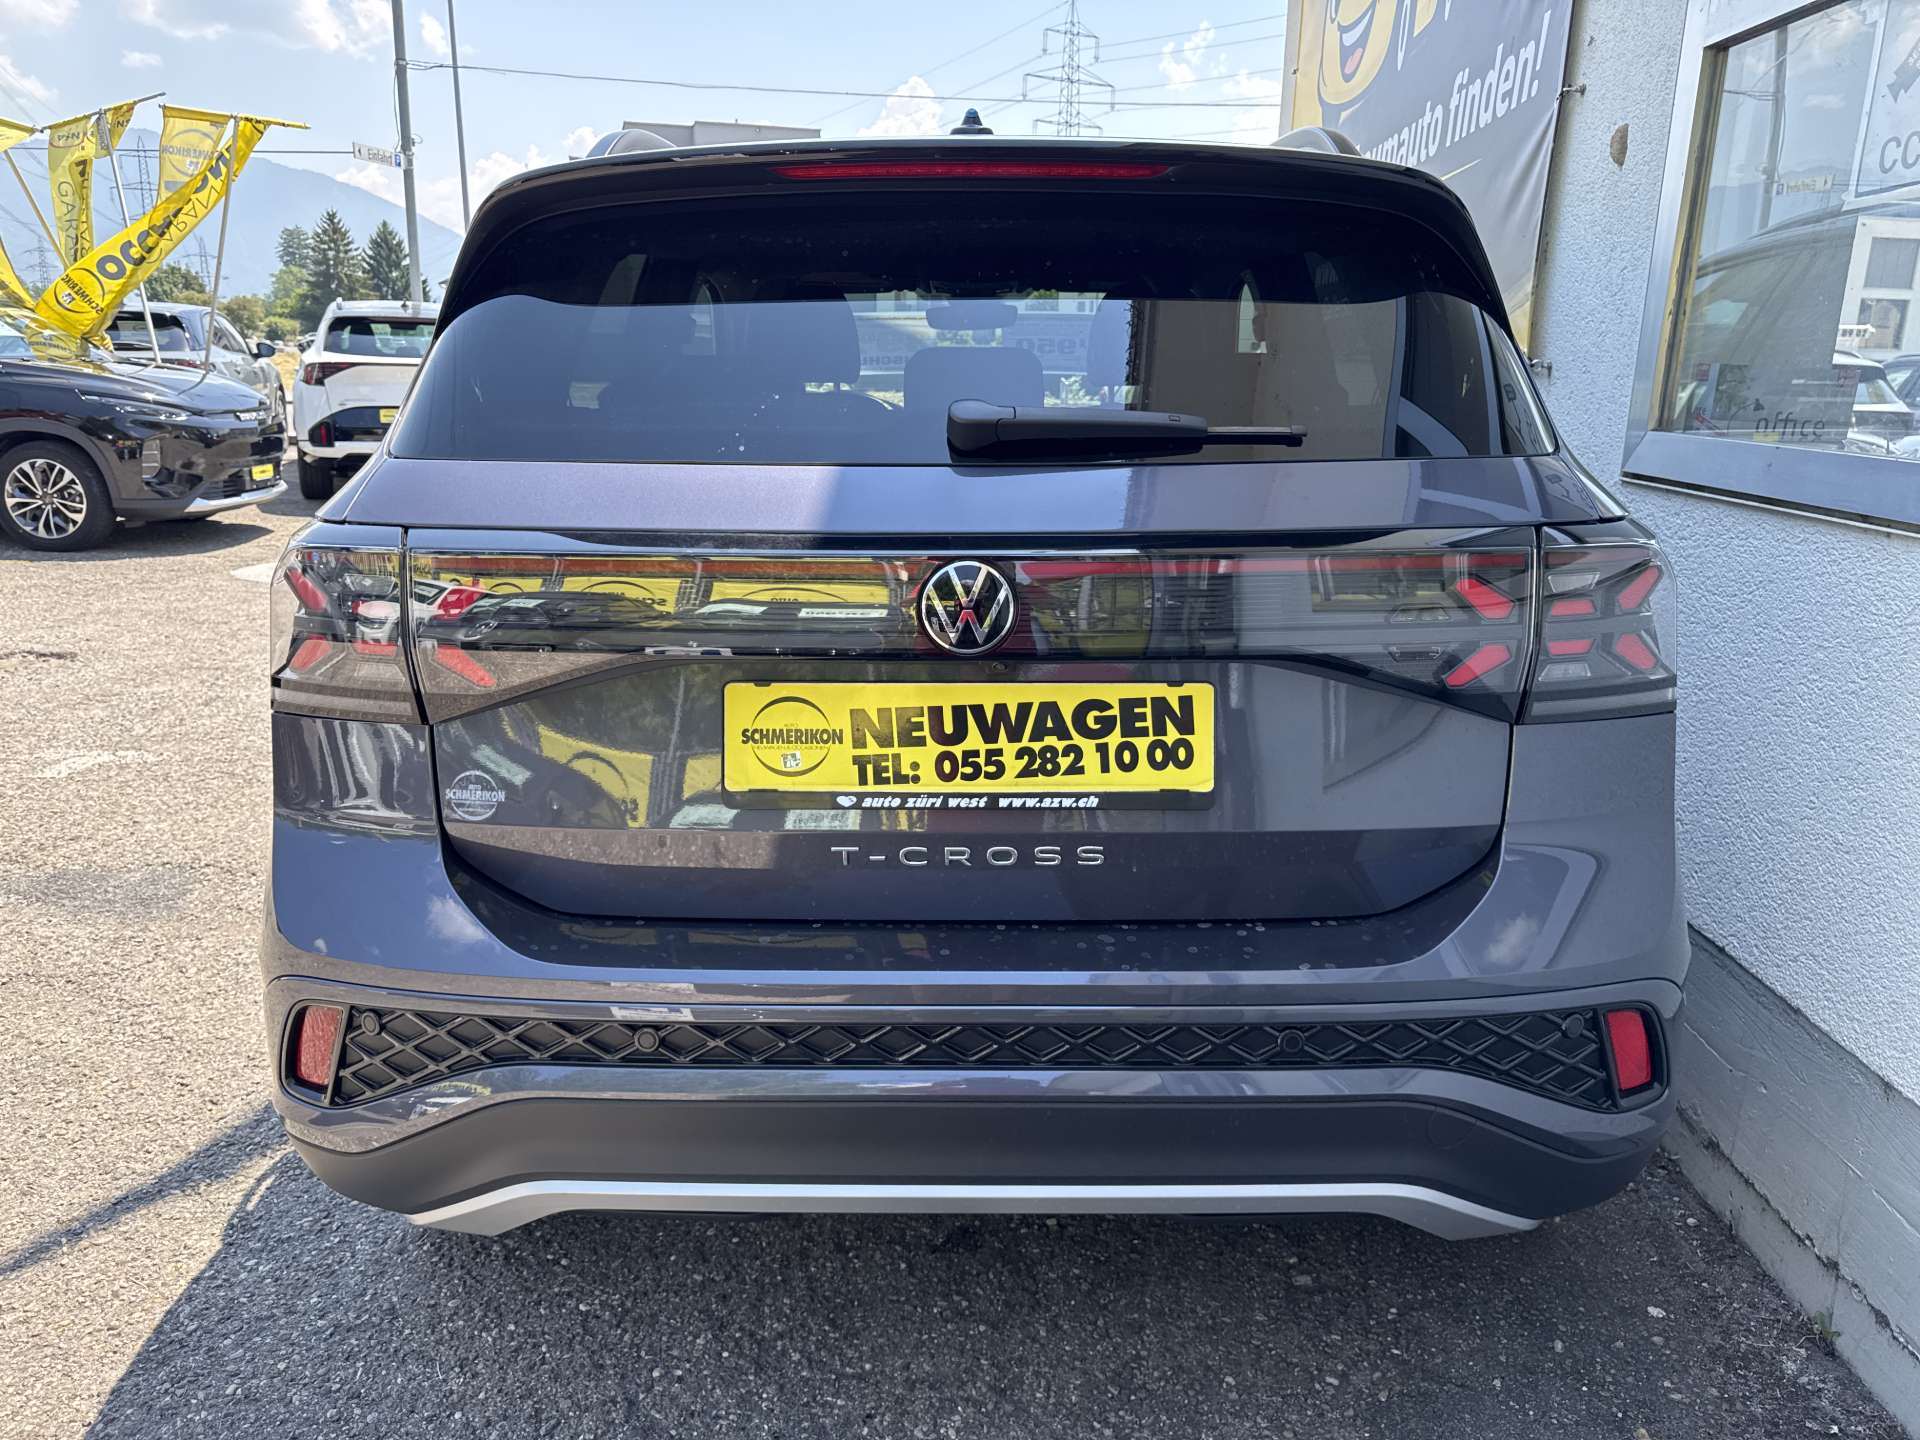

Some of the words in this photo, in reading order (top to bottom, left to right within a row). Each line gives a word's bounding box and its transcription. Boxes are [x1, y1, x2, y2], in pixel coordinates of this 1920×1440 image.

[1446, 10, 1551, 147] finden!
[1755, 411, 1825, 439] office
[850, 695, 1195, 749] NEUWAGEN
[741, 728, 844, 745] SCHMERIKON
[852, 753, 921, 786] TEL:
[935, 747, 1006, 782] 055
[1015, 743, 1085, 778] 282
[1095, 740, 1139, 773] 10
[1147, 738, 1194, 771] 00
[445, 788, 506, 802] SCHMERIKON
[862, 796, 901, 807] auto
[948, 795, 987, 807] west
[998, 796, 1099, 807] www.azw.ch
[831, 846, 1104, 866] T-CROSS
